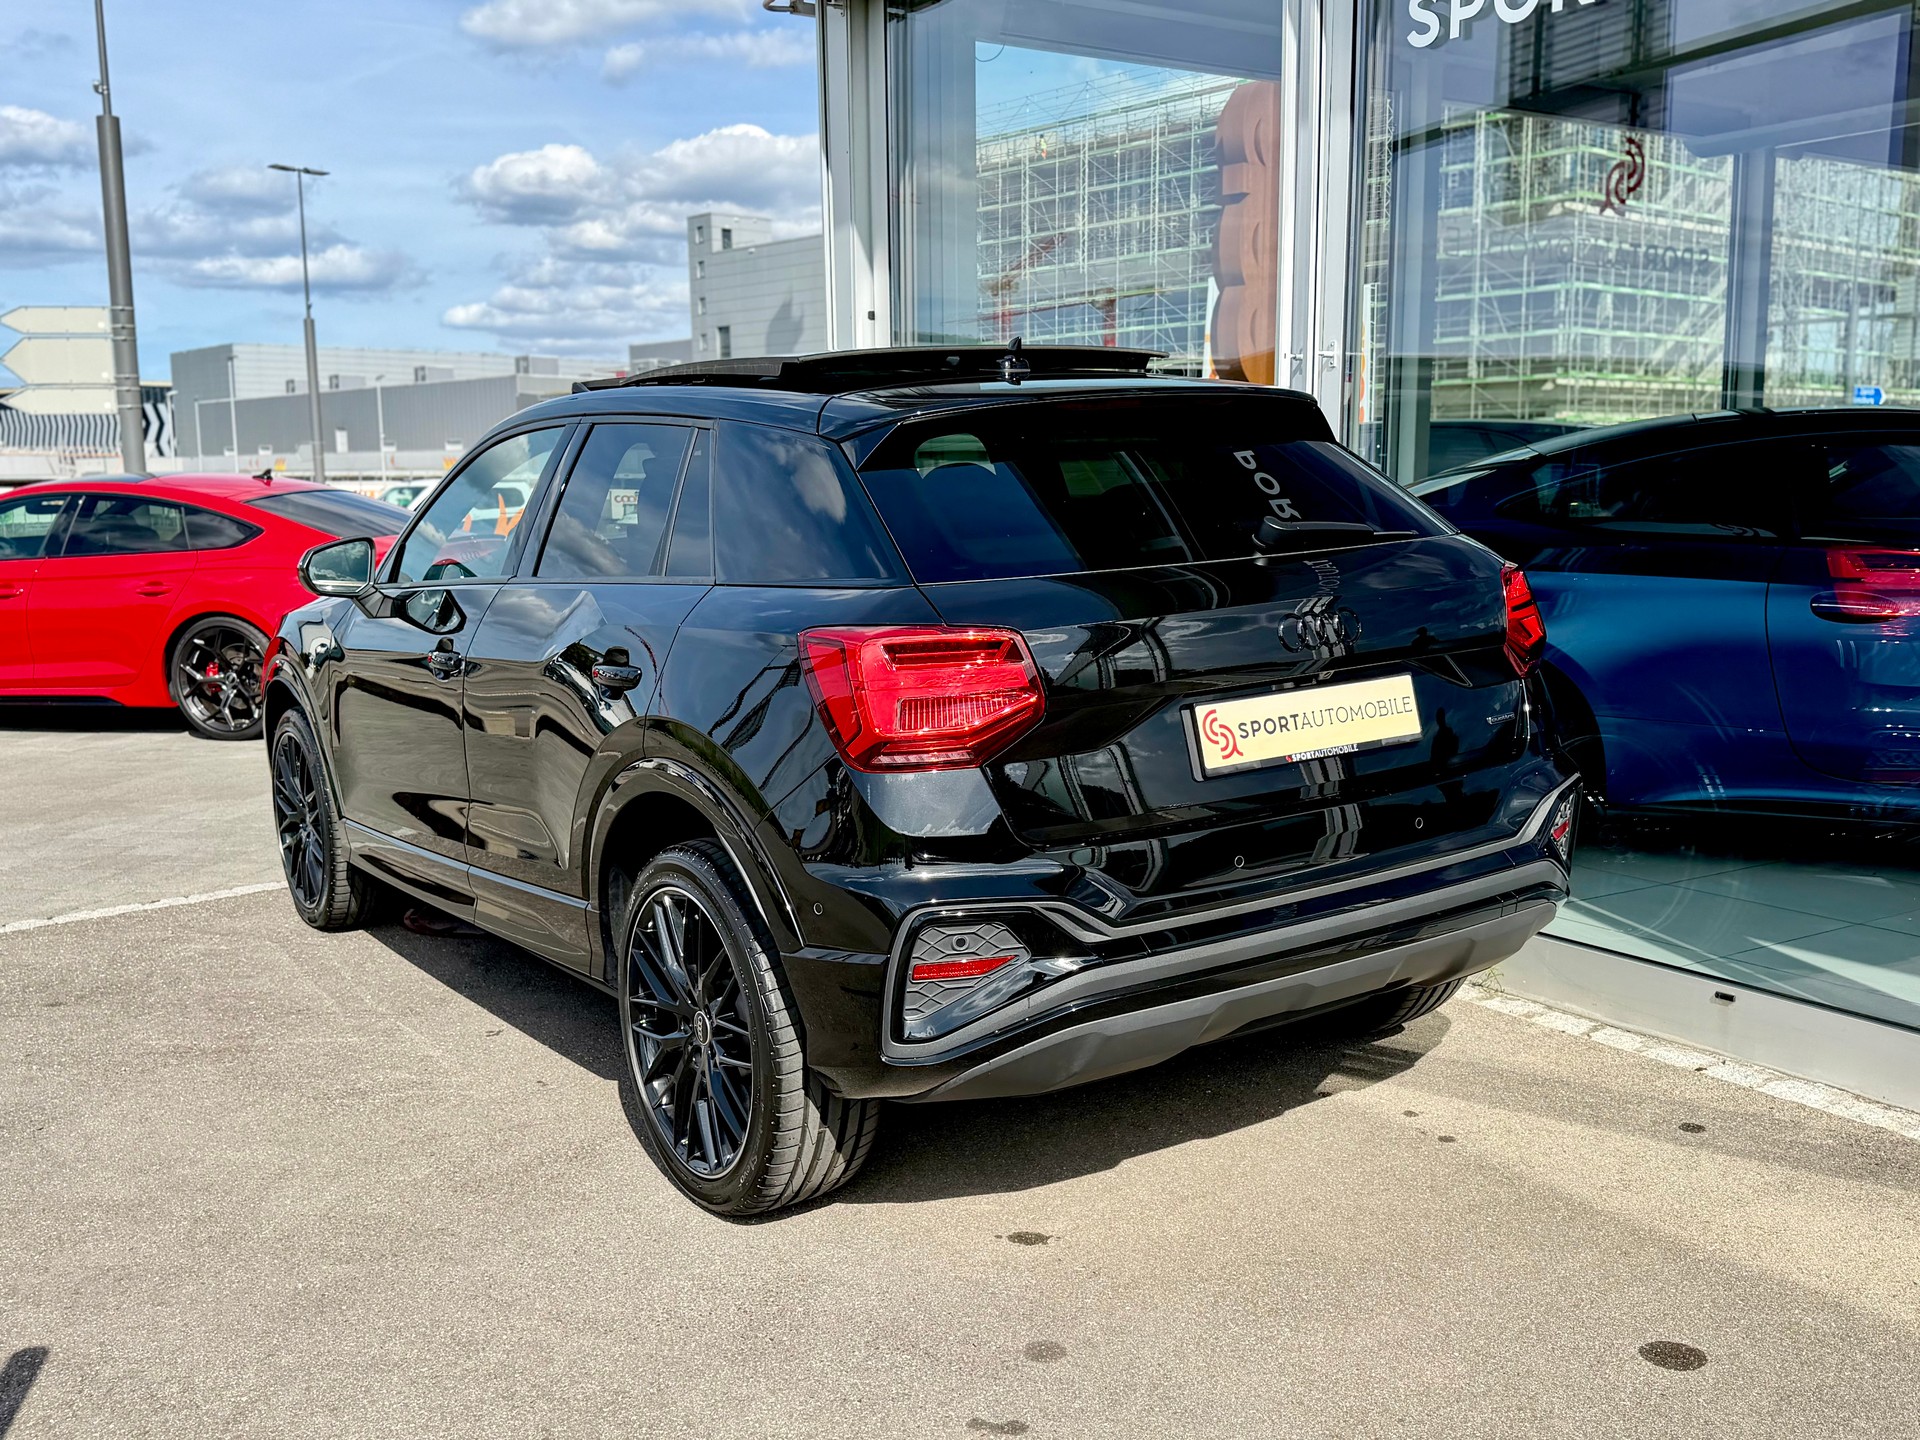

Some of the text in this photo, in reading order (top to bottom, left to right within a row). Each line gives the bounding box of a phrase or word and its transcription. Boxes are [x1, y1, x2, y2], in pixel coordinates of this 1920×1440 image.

[1407, 0, 1596, 48] SPO
[1238, 696, 1413, 739] SPORTAUTOMOBILE
[1292, 743, 1359, 762] SPORTAUTOMOBILE
